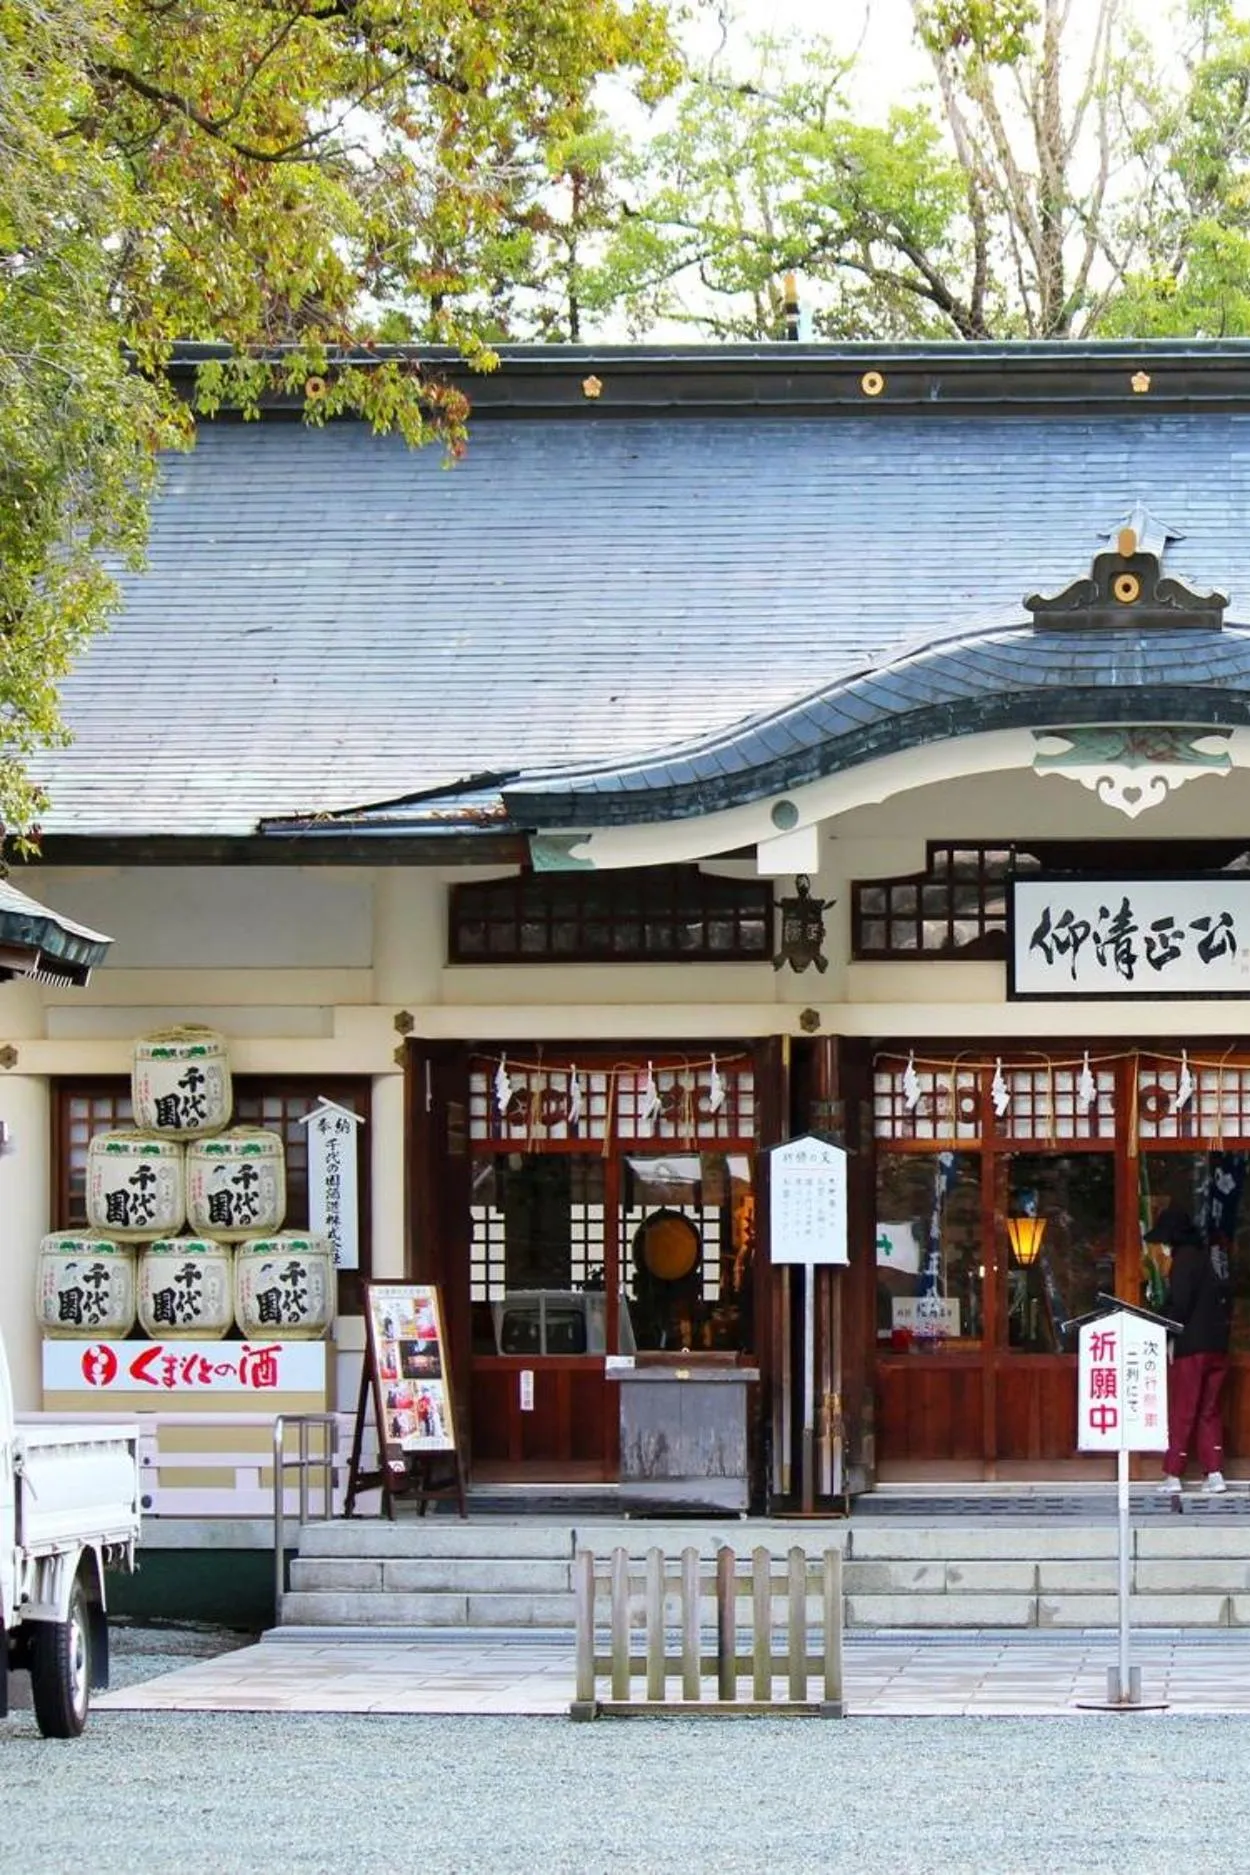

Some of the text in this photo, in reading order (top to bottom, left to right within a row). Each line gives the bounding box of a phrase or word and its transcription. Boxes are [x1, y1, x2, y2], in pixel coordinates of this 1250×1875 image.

[317, 1117, 350, 1134] 奉納
[129, 1345, 283, 1388] くまもとの酒
[1089, 1331, 1118, 1435] 祈願中
